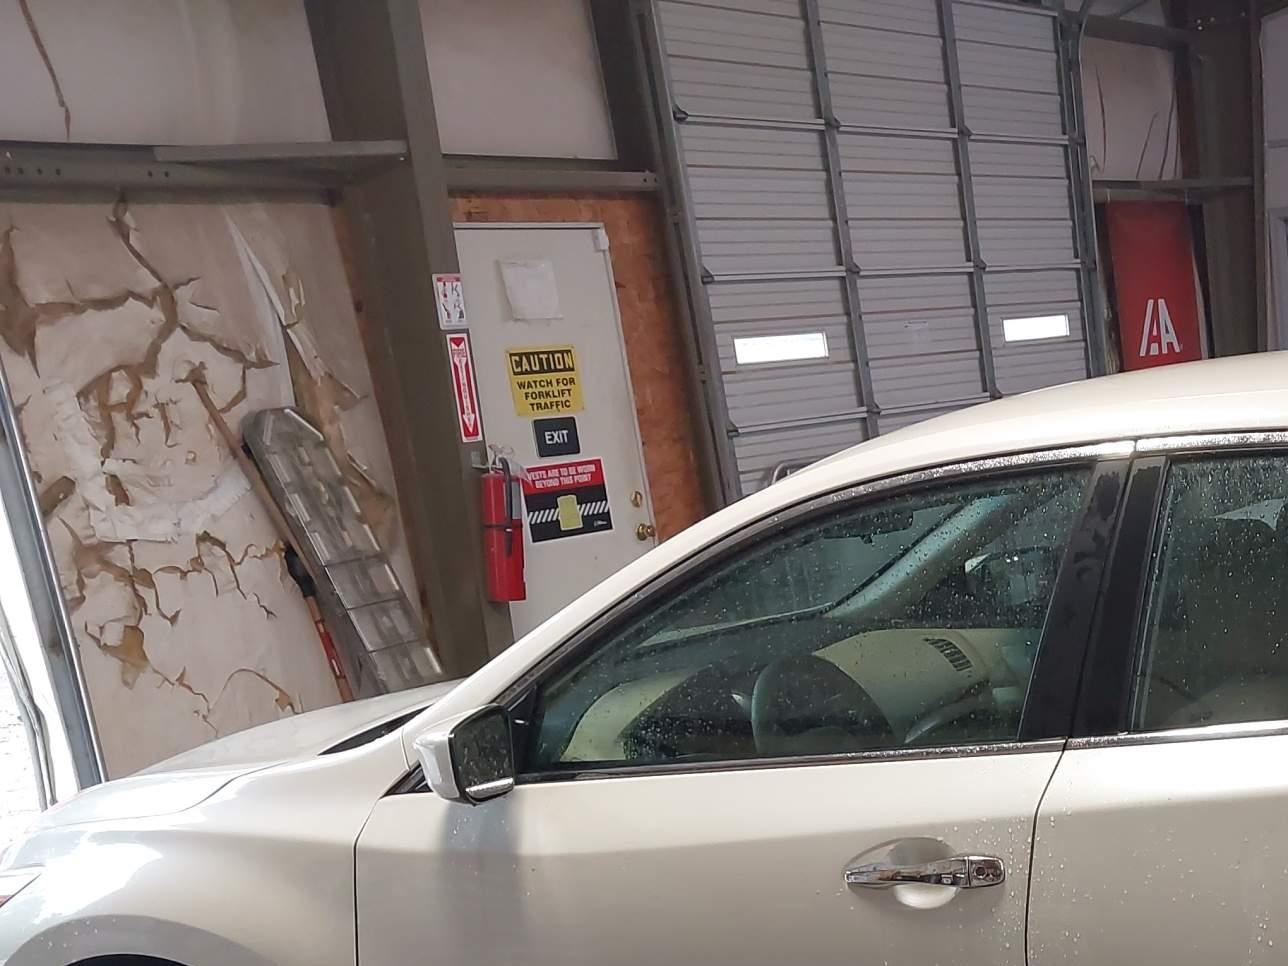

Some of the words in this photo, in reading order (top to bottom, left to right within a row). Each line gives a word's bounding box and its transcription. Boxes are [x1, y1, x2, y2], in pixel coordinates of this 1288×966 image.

[510, 352, 574, 373] CAUTION
[516, 378, 553, 390] WATCH
[556, 377, 576, 387] FOR
[524, 388, 572, 401] FORKLIFT
[529, 399, 572, 412] TRAFFIC
[544, 430, 569, 445] EXIT
[527, 470, 547, 481] VESTS
[547, 469, 560, 478] ARE
[560, 467, 568, 476] TO
[568, 466, 577, 475] BE
[535, 478, 560, 489] BEYOND
[560, 476, 574, 486] THIS
[574, 473, 592, 483] POINT
